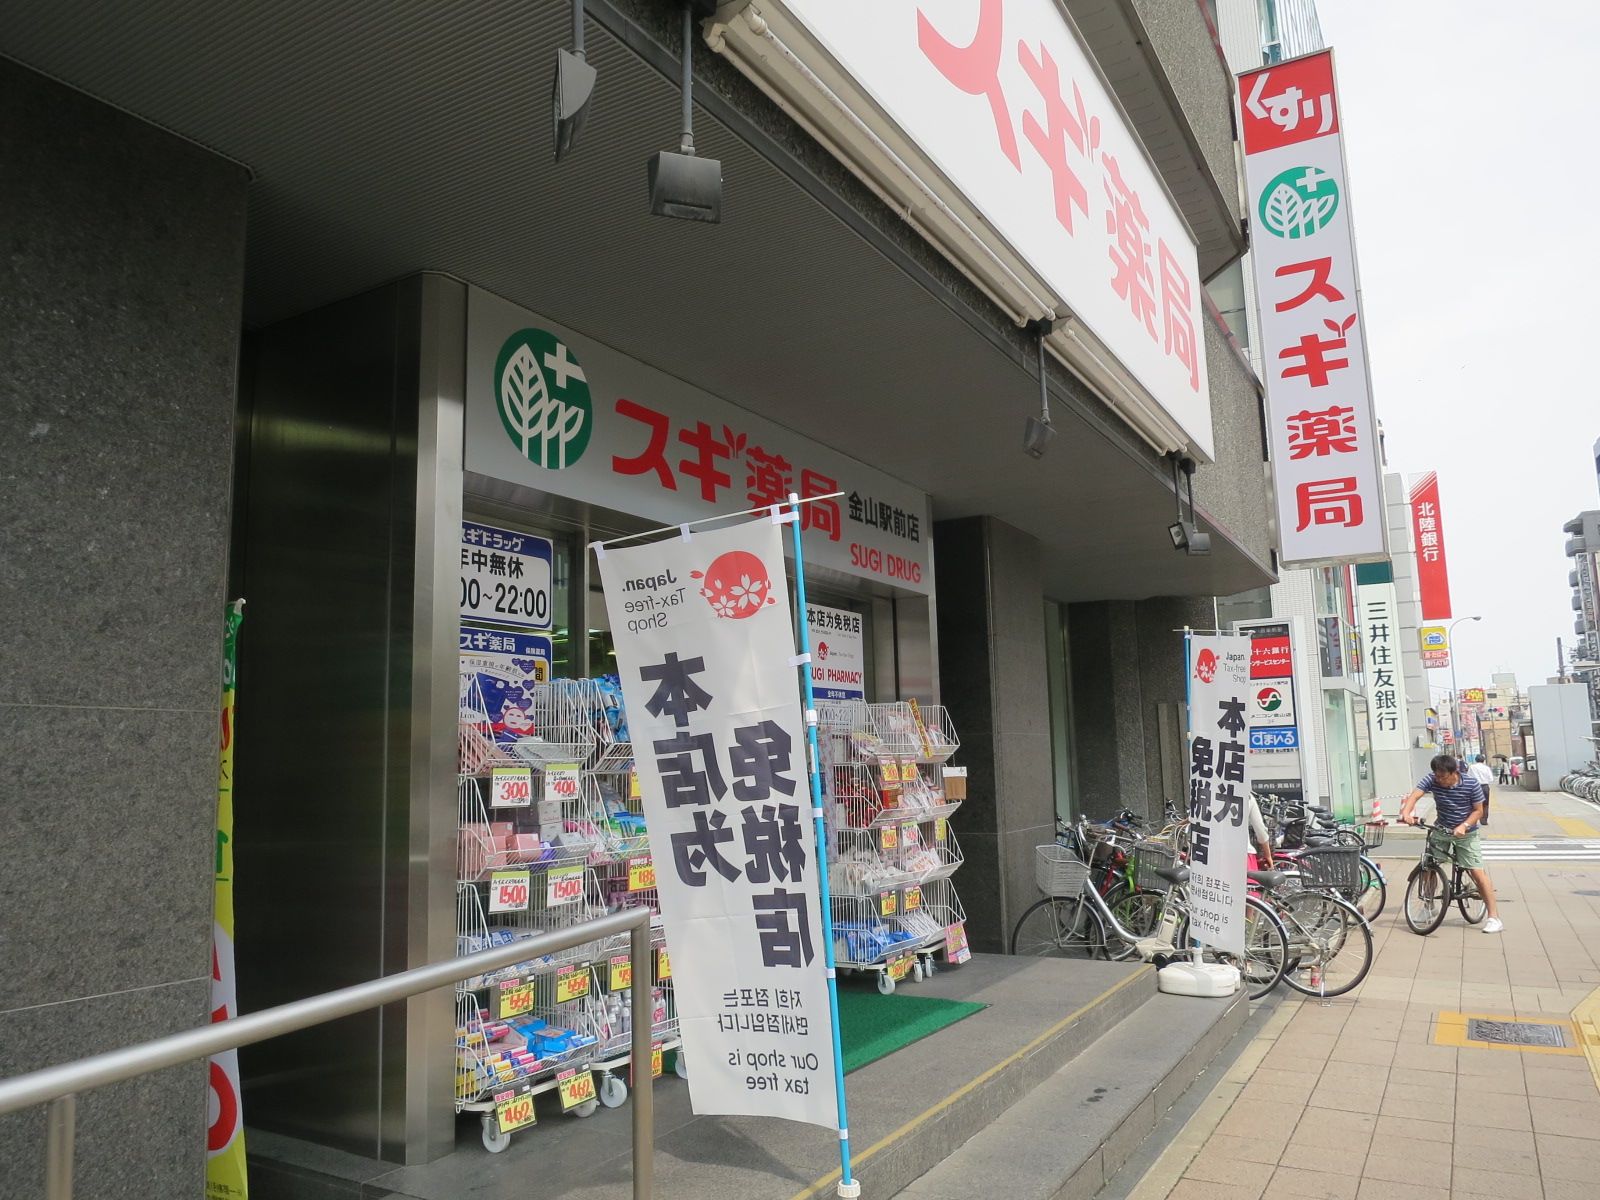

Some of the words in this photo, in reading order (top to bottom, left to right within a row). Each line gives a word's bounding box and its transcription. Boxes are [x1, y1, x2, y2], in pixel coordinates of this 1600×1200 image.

[1246, 72, 1333, 135] くすり
[1274, 256, 1365, 532] スギ薬局
[612, 398, 841, 543] スギ薬局
[848, 490, 920, 544] 金山駅前店
[1417, 501, 1439, 563] 北陸銀行
[851, 542, 883, 574] SUGI
[887, 553, 922, 584] DRUG
[807, 608, 860, 635] 本店为免税店
[459, 632, 517, 653] スギ薬局
[811, 667, 825, 681] UGI
[827, 669, 863, 685] PHARMACY
[1367, 602, 1399, 732] 三井住友銀行
[1251, 731, 1295, 747] すまいる
[1213, 697, 1247, 827] 本店为
[500, 781, 528, 800] 300
[553, 780, 576, 794] 400
[1190, 736, 1214, 866] 免税店
[553, 879, 580, 898] 1500
[1200, 908, 1220, 923] shop
[1222, 913, 1230, 924] is
[1203, 920, 1221, 935] free
